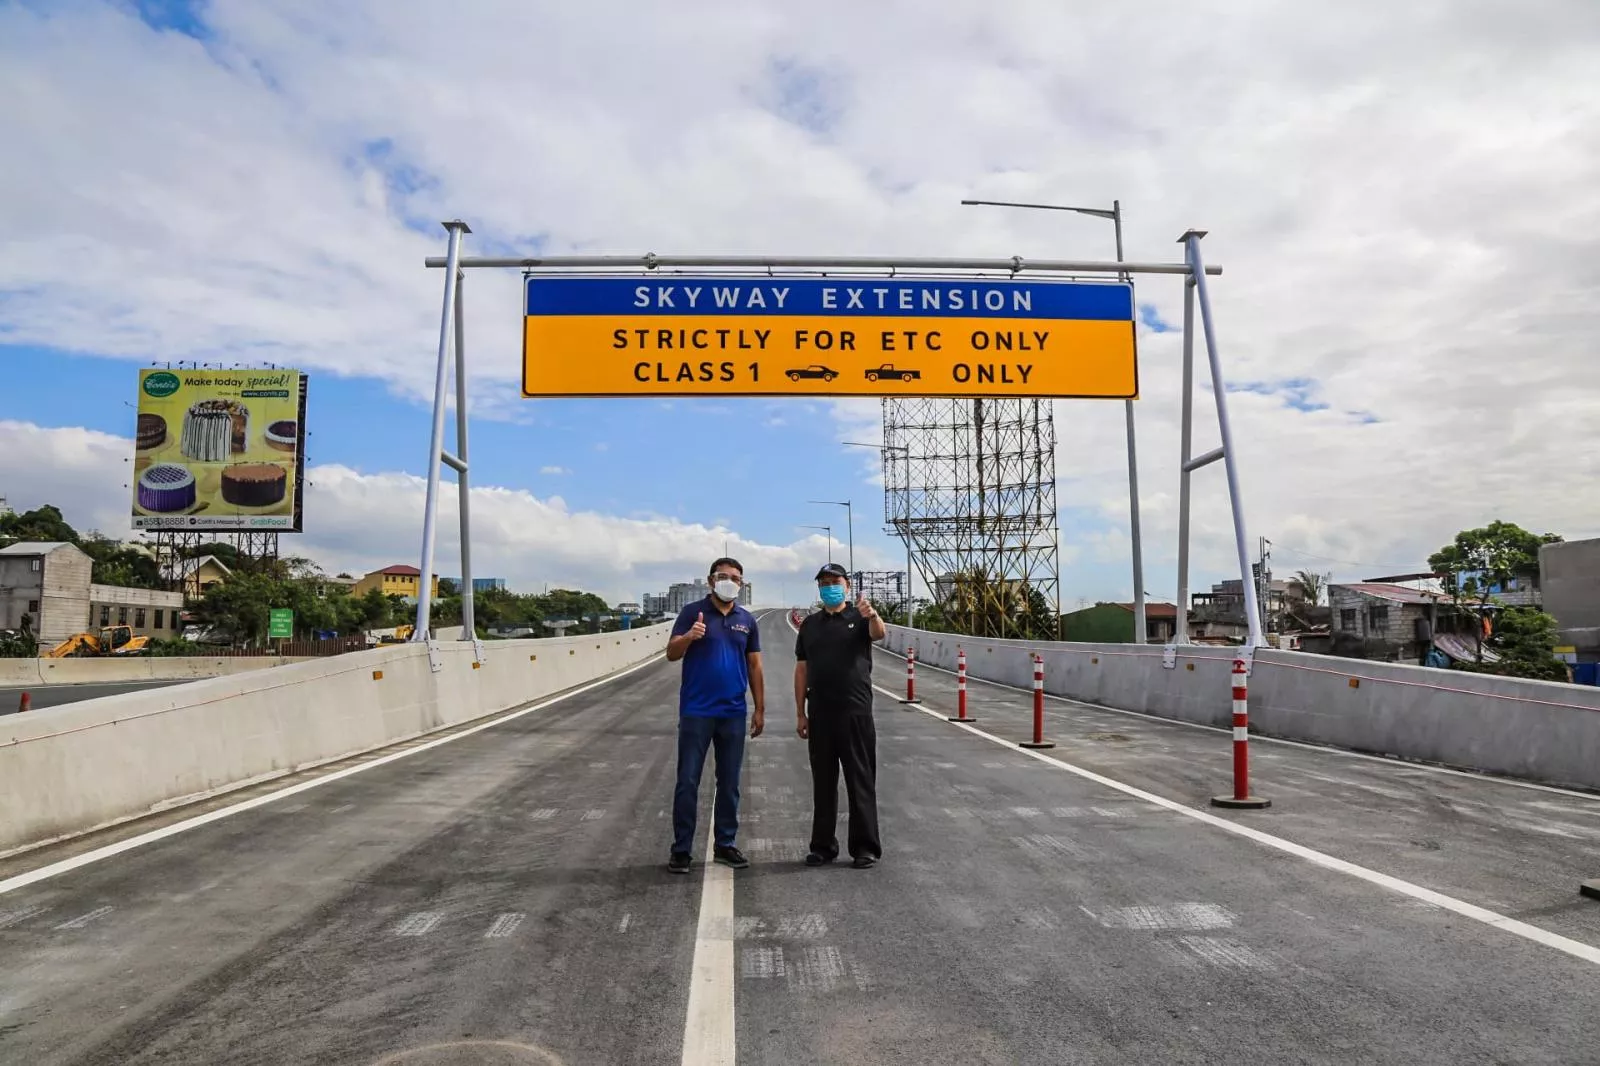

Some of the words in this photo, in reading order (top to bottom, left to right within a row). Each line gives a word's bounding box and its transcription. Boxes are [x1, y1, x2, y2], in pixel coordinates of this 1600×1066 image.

[633, 286, 790, 308] SKYWAY
[822, 287, 1032, 311] EXTENSION
[613, 329, 771, 349] STRICTLY
[795, 330, 856, 350] FOR
[881, 331, 942, 350] ETC
[971, 331, 1050, 350] ONLY
[184, 378, 212, 386] Make
[214, 377, 243, 387] today
[246, 374, 290, 389] special!
[634, 362, 735, 382] CLASS
[748, 362, 760, 381] 1
[952, 363, 1033, 383] ONLY
